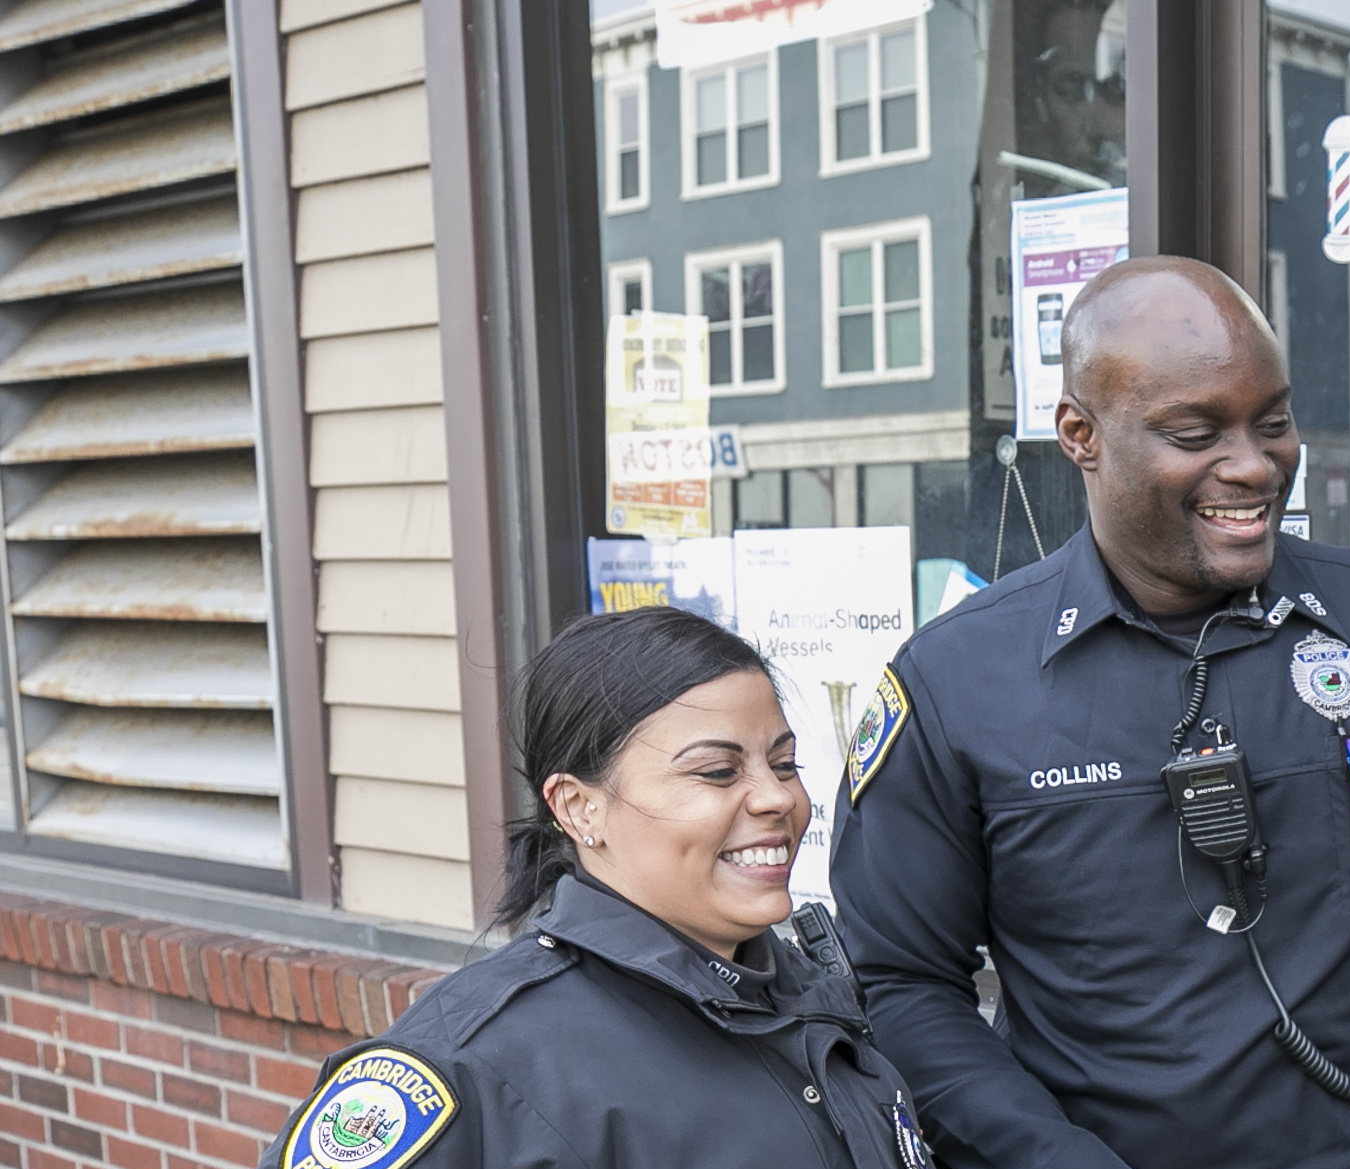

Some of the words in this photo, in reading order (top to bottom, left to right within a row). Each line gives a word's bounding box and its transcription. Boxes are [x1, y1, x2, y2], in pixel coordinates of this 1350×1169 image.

[600, 582, 669, 613] YOUNG
[769, 608, 901, 634] Animal-Shaped
[1057, 607, 1079, 636] CPD
[768, 638, 833, 656] Vessels
[1303, 650, 1345, 662] POLICE
[1030, 762, 1122, 789] COLLINS
[1196, 783, 1236, 795] MOTOROLA
[338, 1059, 443, 1116] CAMBRIDGE
[322, 1126, 377, 1158] CANTABRIGIA
